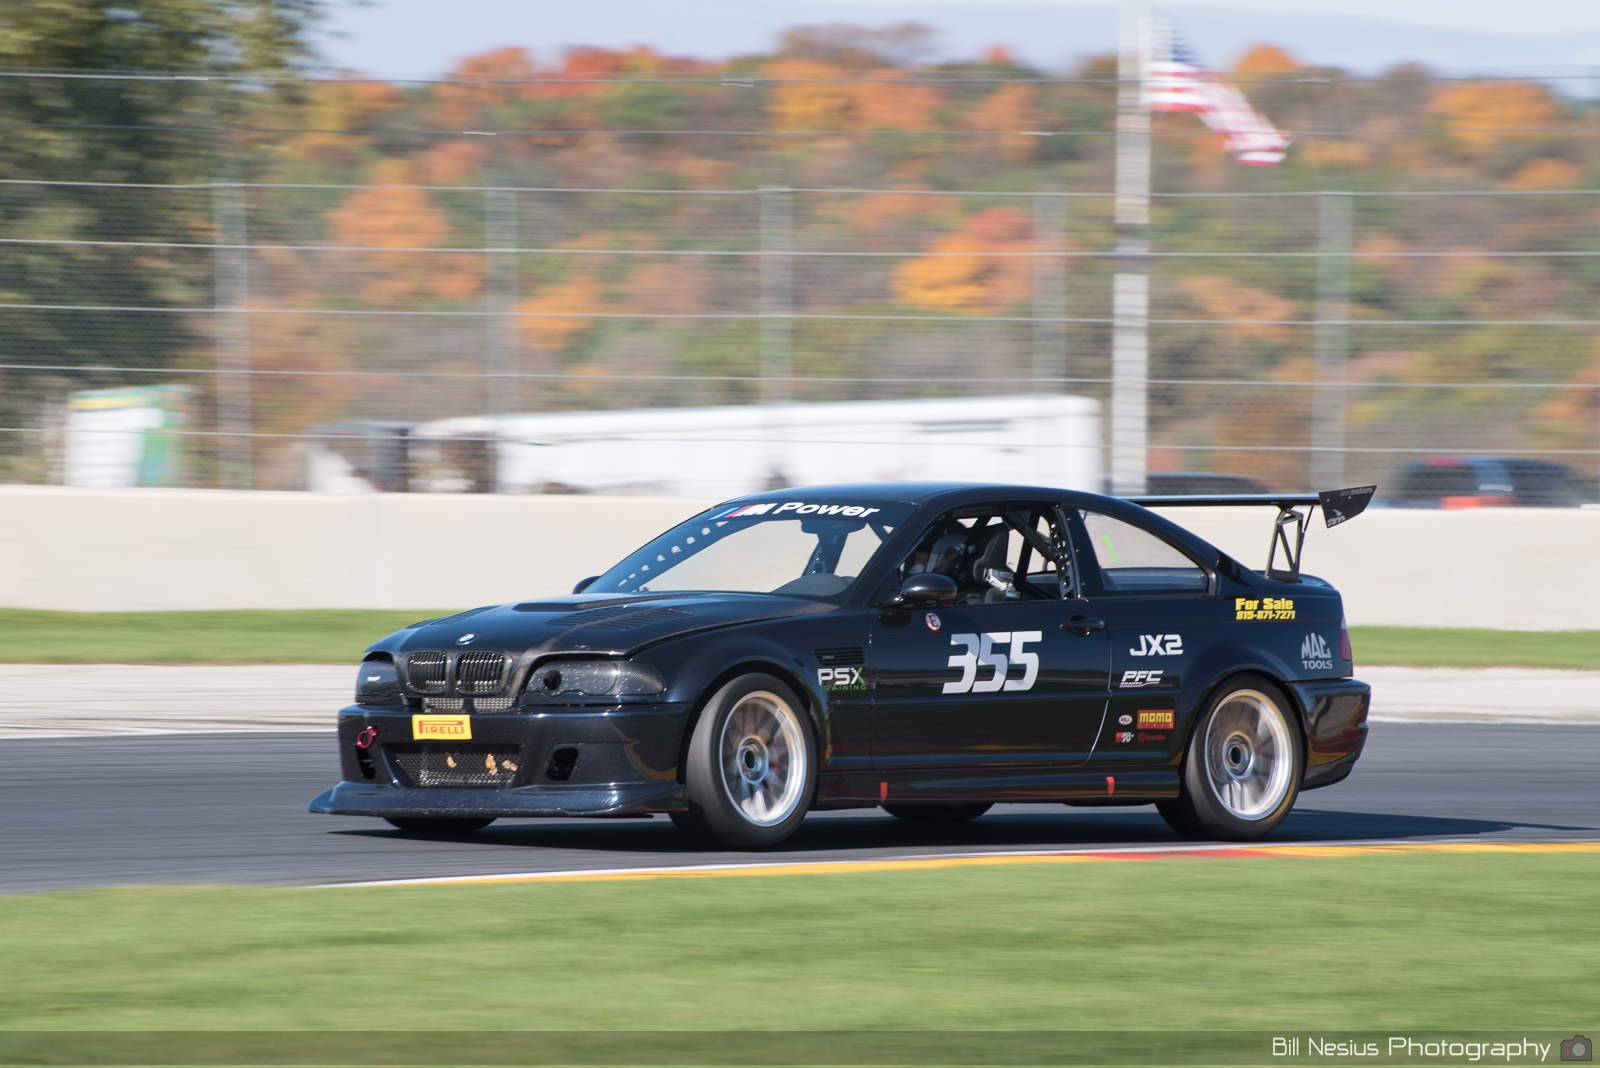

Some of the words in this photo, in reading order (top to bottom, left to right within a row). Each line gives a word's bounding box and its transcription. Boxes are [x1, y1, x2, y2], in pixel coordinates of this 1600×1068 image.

[772, 502, 881, 518] Power
[1235, 598, 1259, 611] For
[1263, 597, 1294, 610] Sale
[1236, 610, 1296, 620] 815-871-7271
[1129, 634, 1184, 656] JX2
[1301, 632, 1332, 659] MAC
[942, 631, 1042, 694] 355
[1302, 660, 1333, 669] TOOLS
[817, 667, 866, 686] PSX
[1121, 670, 1164, 682] PFC
[419, 720, 464, 734] PIRELLI
